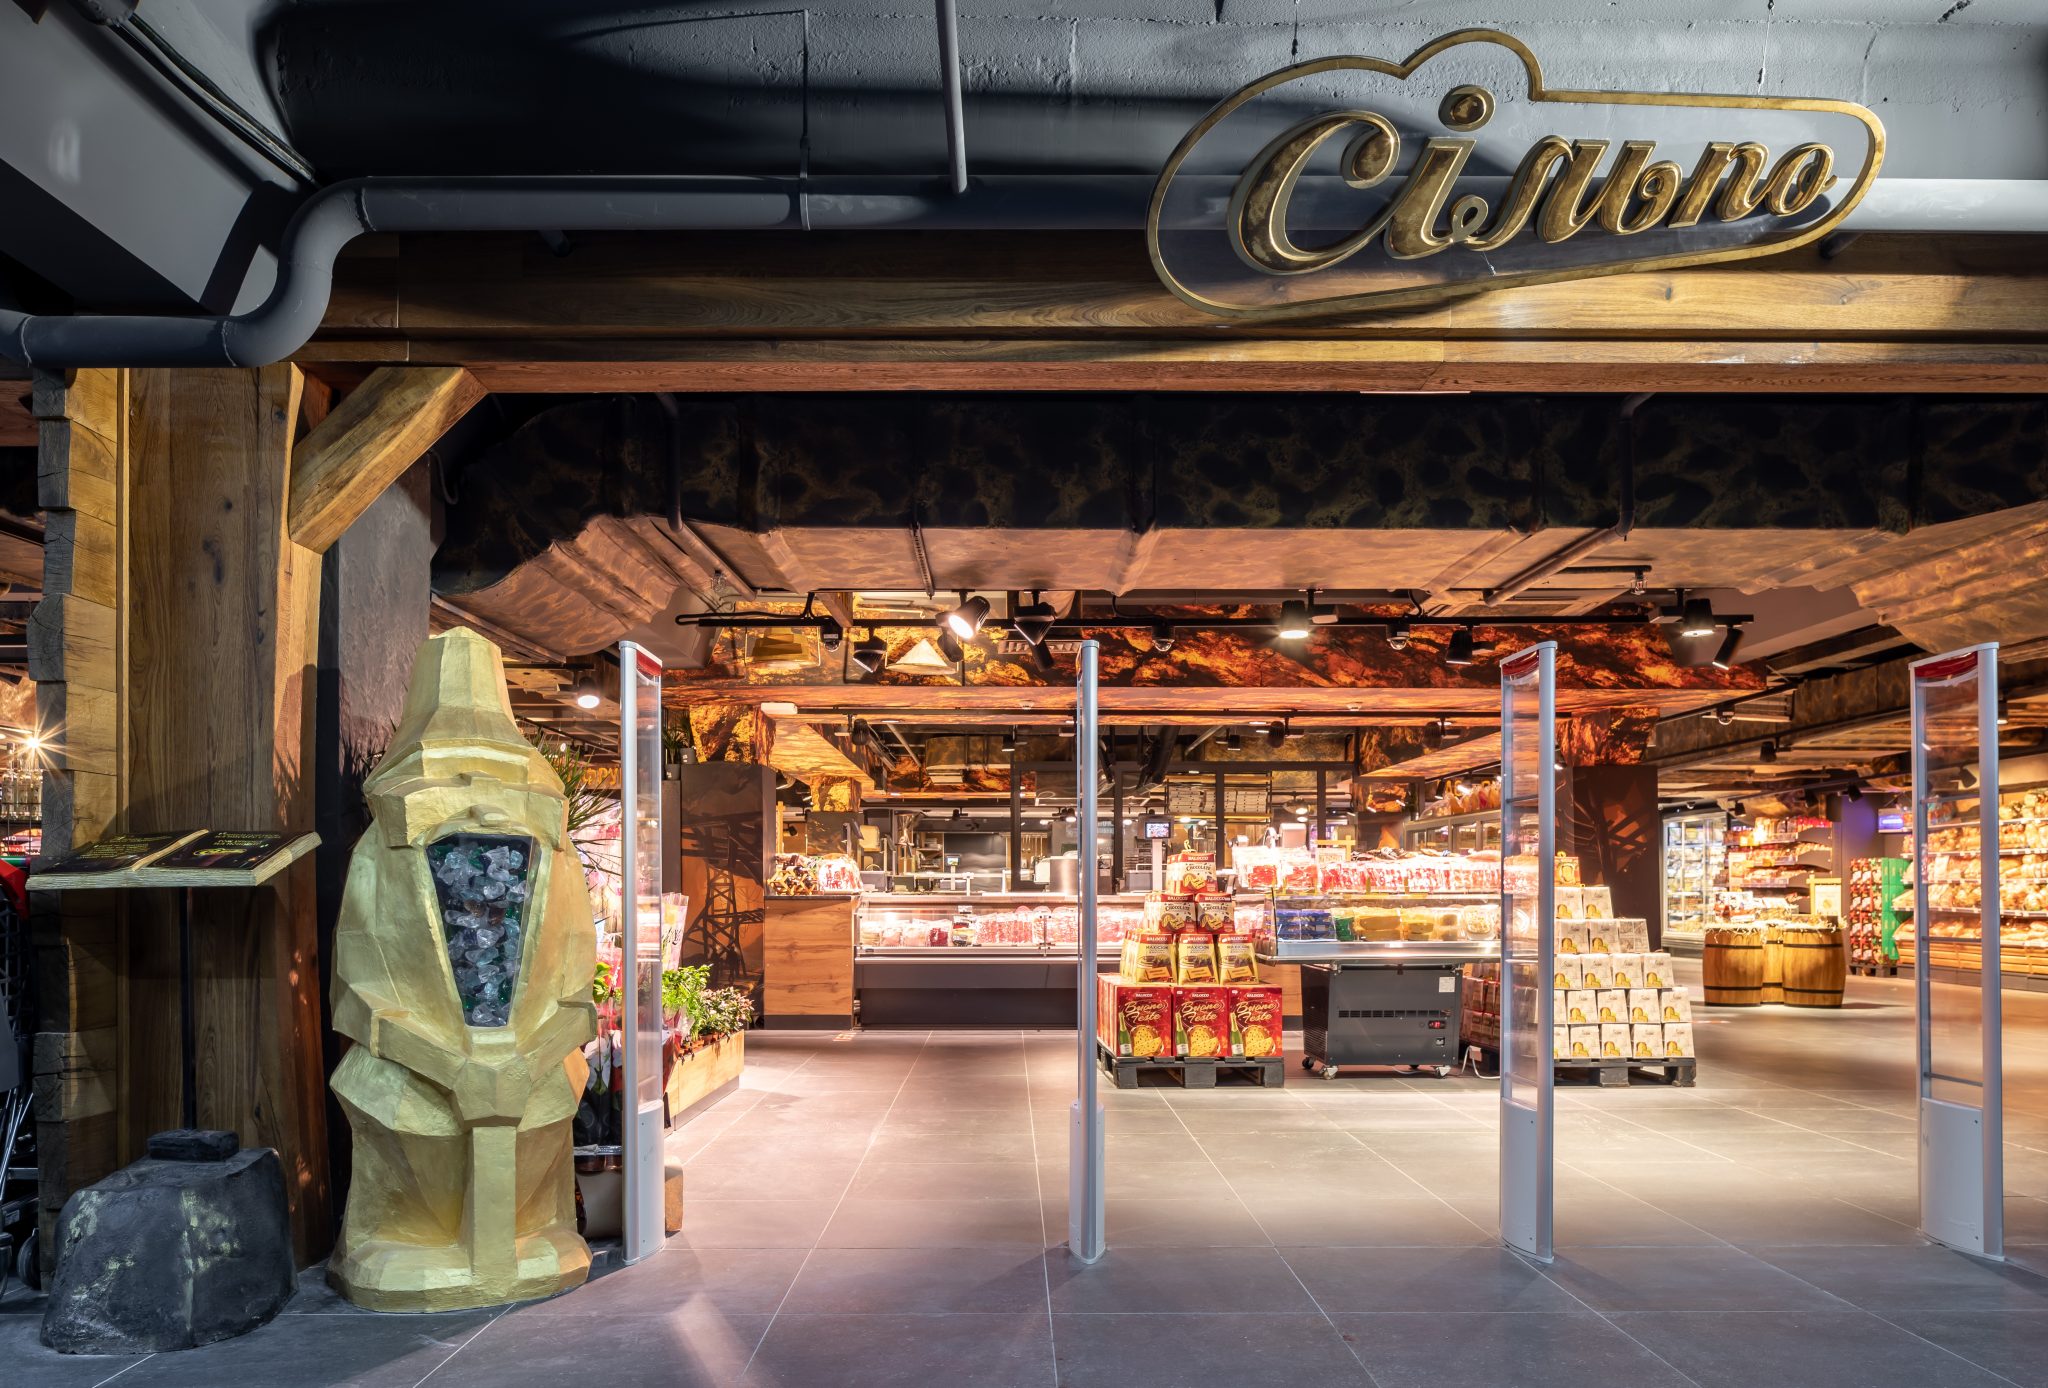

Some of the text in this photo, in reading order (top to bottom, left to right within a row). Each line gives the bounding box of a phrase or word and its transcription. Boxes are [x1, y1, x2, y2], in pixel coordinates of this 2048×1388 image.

[1124, 1001, 1163, 1013] Buone
[1181, 1001, 1220, 1013] Buone
[1236, 1001, 1275, 1013] Buone
[1129, 1011, 1161, 1023] Feste
[1186, 1011, 1218, 1023] Feste
[1240, 1011, 1272, 1023] Feste
